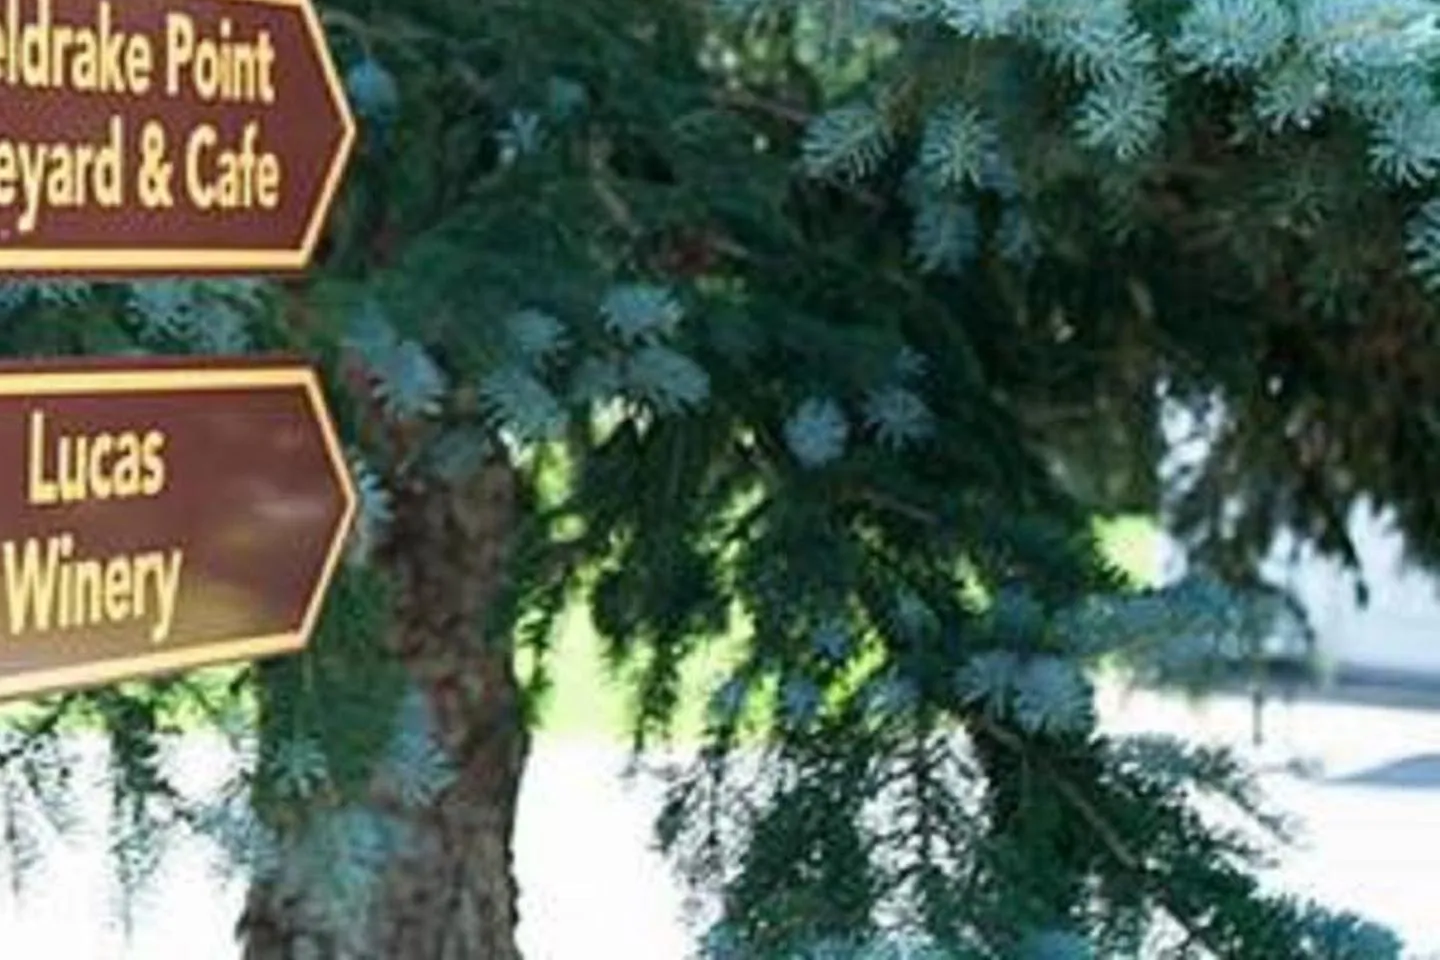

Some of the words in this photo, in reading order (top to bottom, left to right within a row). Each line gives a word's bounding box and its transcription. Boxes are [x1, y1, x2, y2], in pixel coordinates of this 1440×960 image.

[166, 11, 276, 104] Point
[136, 120, 174, 208] &
[185, 118, 280, 209] Cafe
[28, 409, 166, 506] Lucas
[2, 532, 183, 646] Winery
